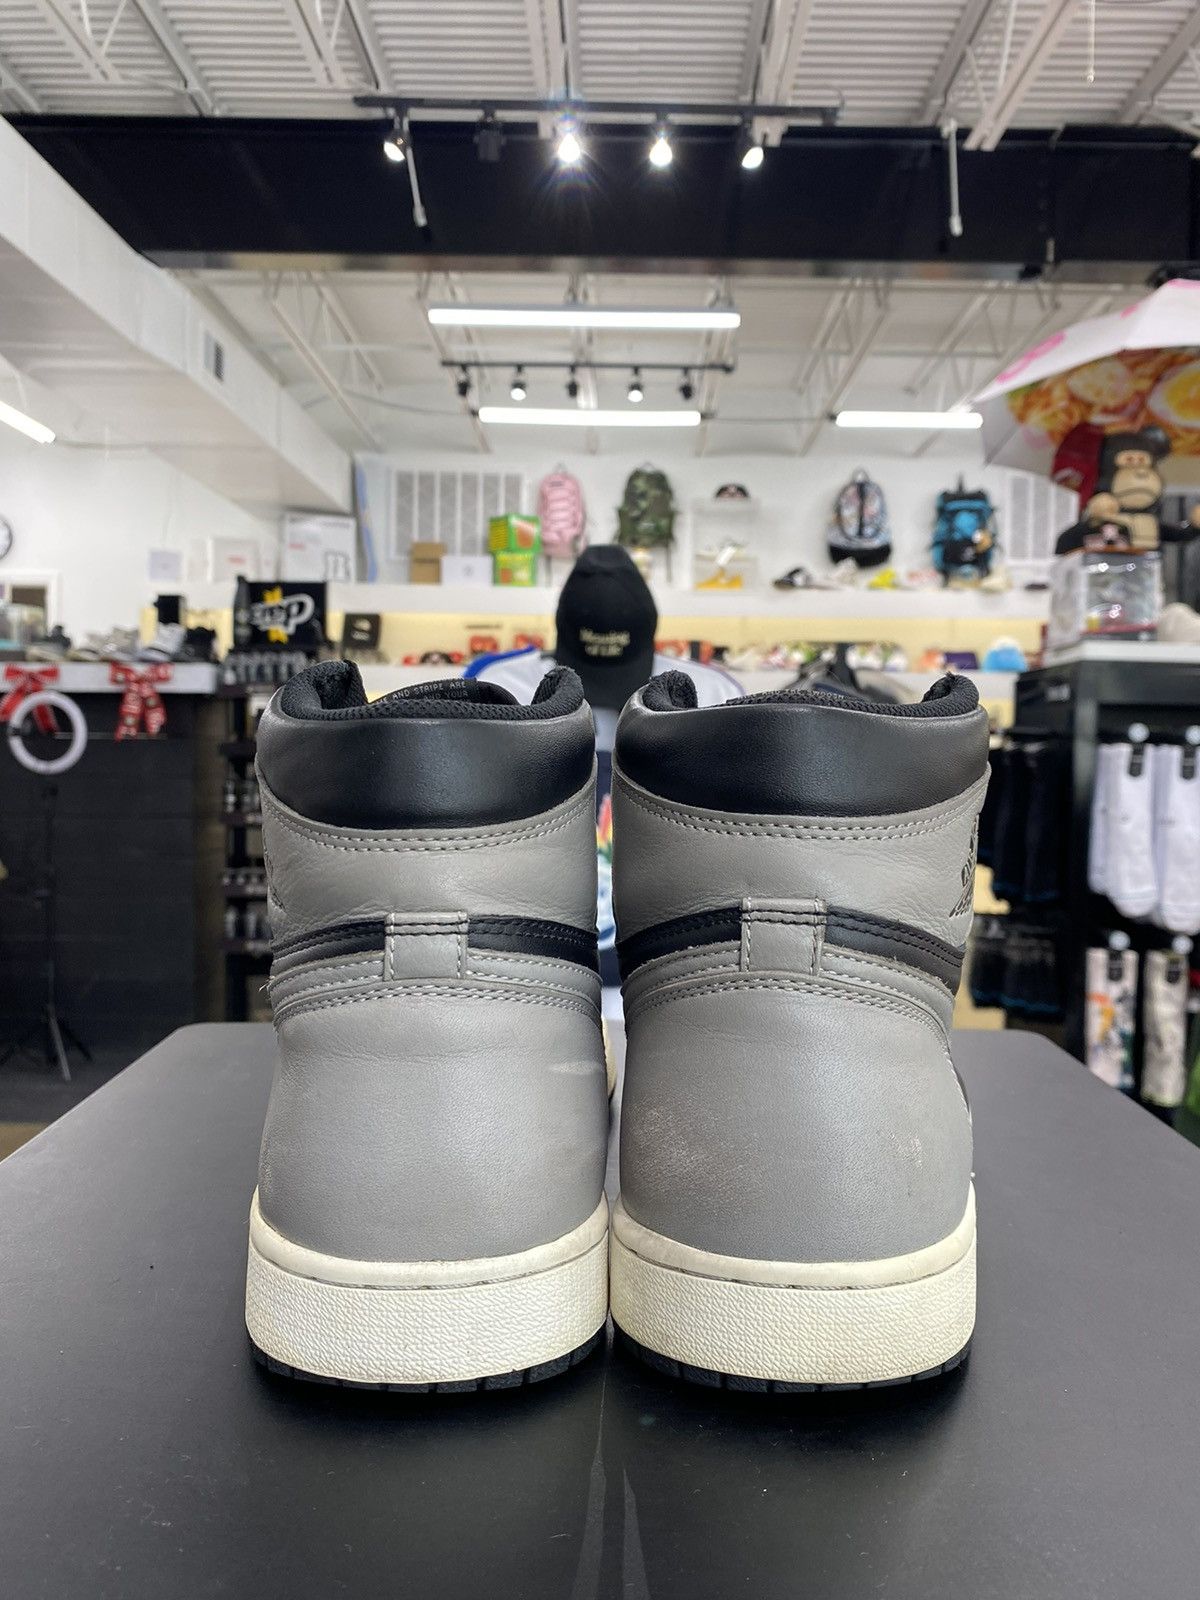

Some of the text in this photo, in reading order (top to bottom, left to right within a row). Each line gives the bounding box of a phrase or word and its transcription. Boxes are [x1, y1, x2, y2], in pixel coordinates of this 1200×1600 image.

[392, 681, 466, 700] AND STRIPE ARE
[445, 690, 469, 699] YOUR
